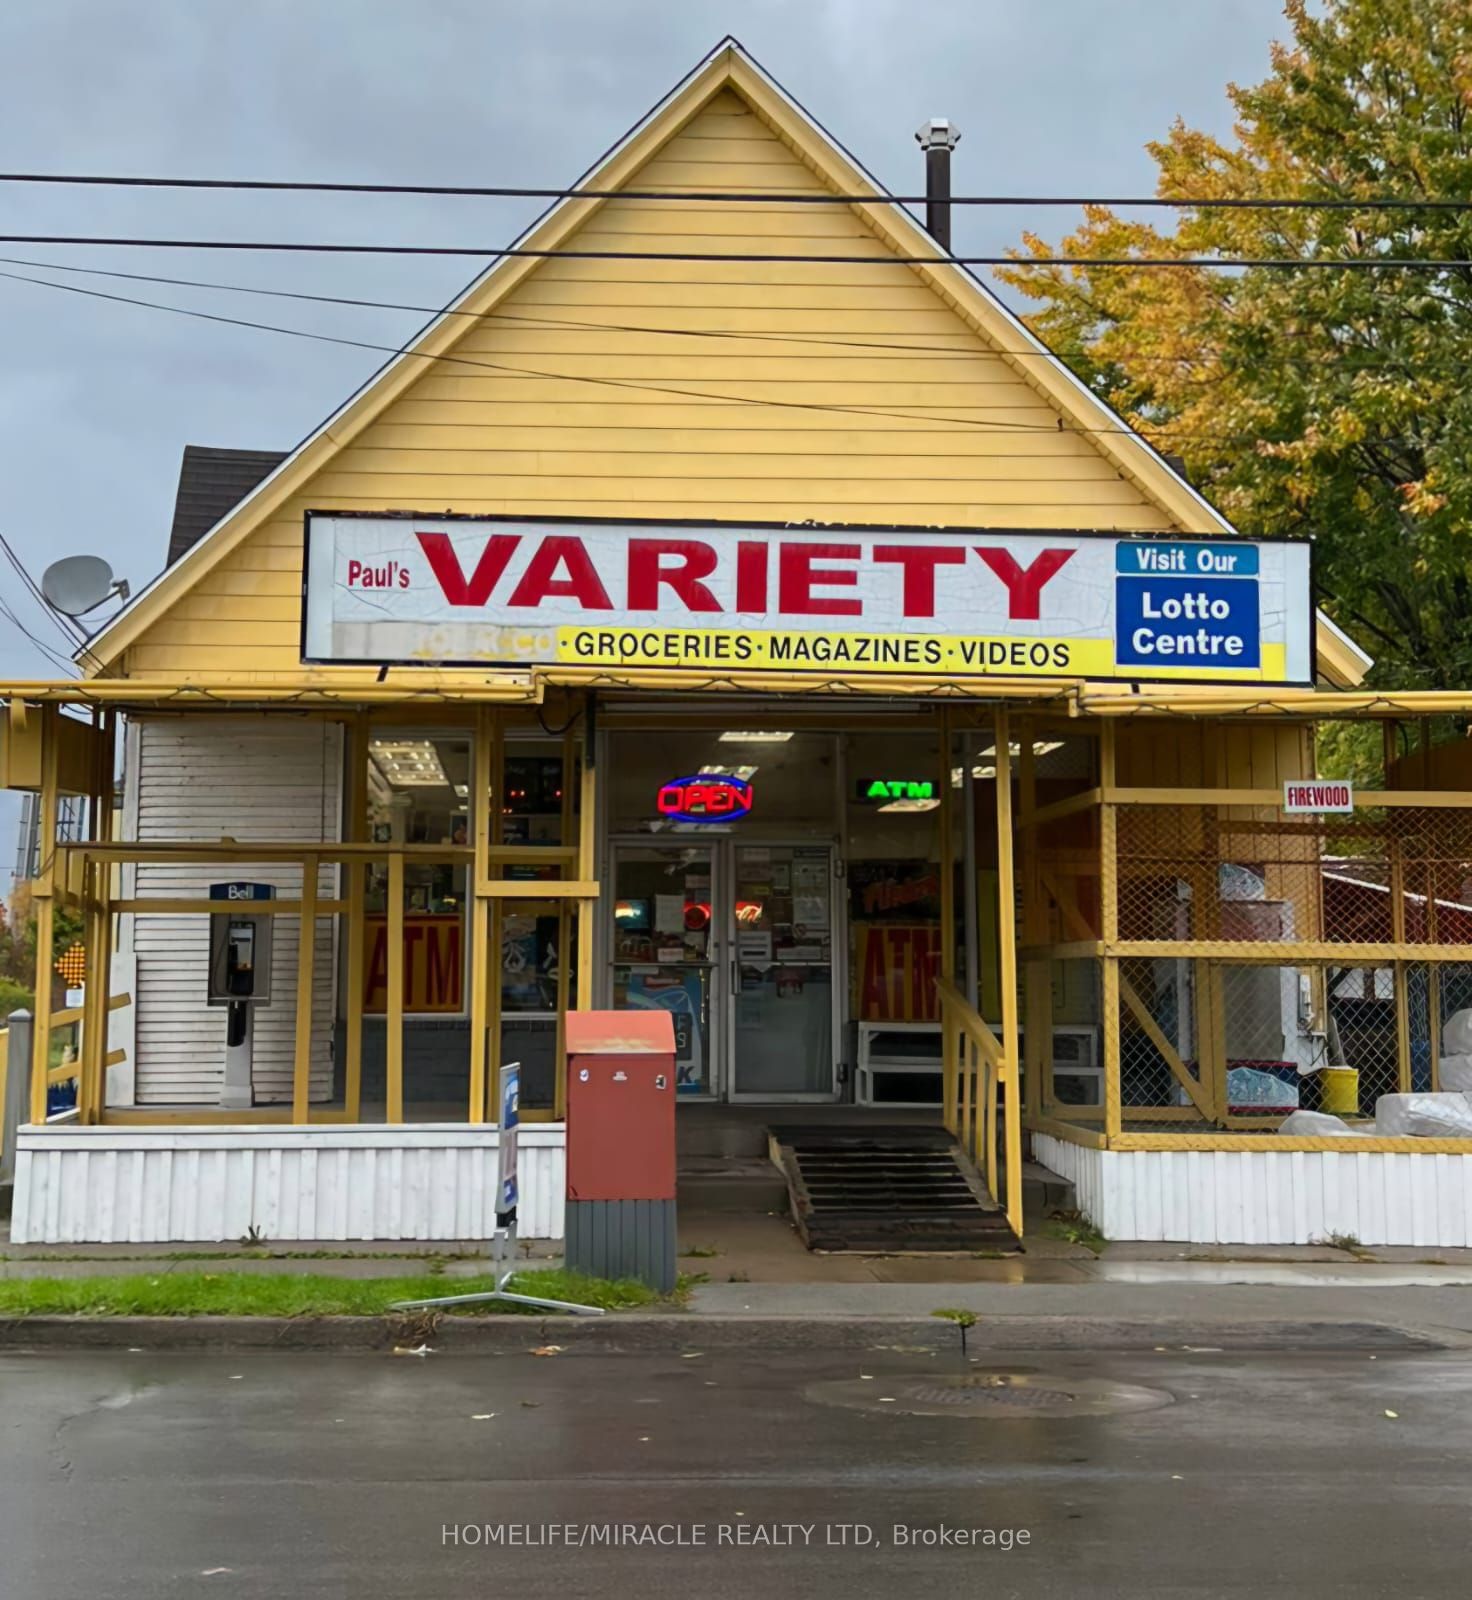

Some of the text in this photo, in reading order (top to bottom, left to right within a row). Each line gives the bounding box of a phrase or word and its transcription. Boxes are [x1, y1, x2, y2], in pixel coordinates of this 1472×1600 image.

[348, 560, 409, 589] Paul's
[415, 532, 1077, 620] VARIETY
[1136, 547, 1237, 575] Visit Our
[1142, 592, 1230, 620] Lotto
[574, 631, 752, 660] GROCERIES
[770, 635, 941, 664] MAGAZINES
[960, 640, 1071, 668] VIDEOS
[1132, 627, 1244, 657] Centre
[657, 783, 753, 814] OPEN
[867, 781, 933, 798] ATM
[1287, 786, 1349, 806] FIREWOOD
[365, 926, 460, 1005] ATM
[862, 928, 945, 1019] ATM
